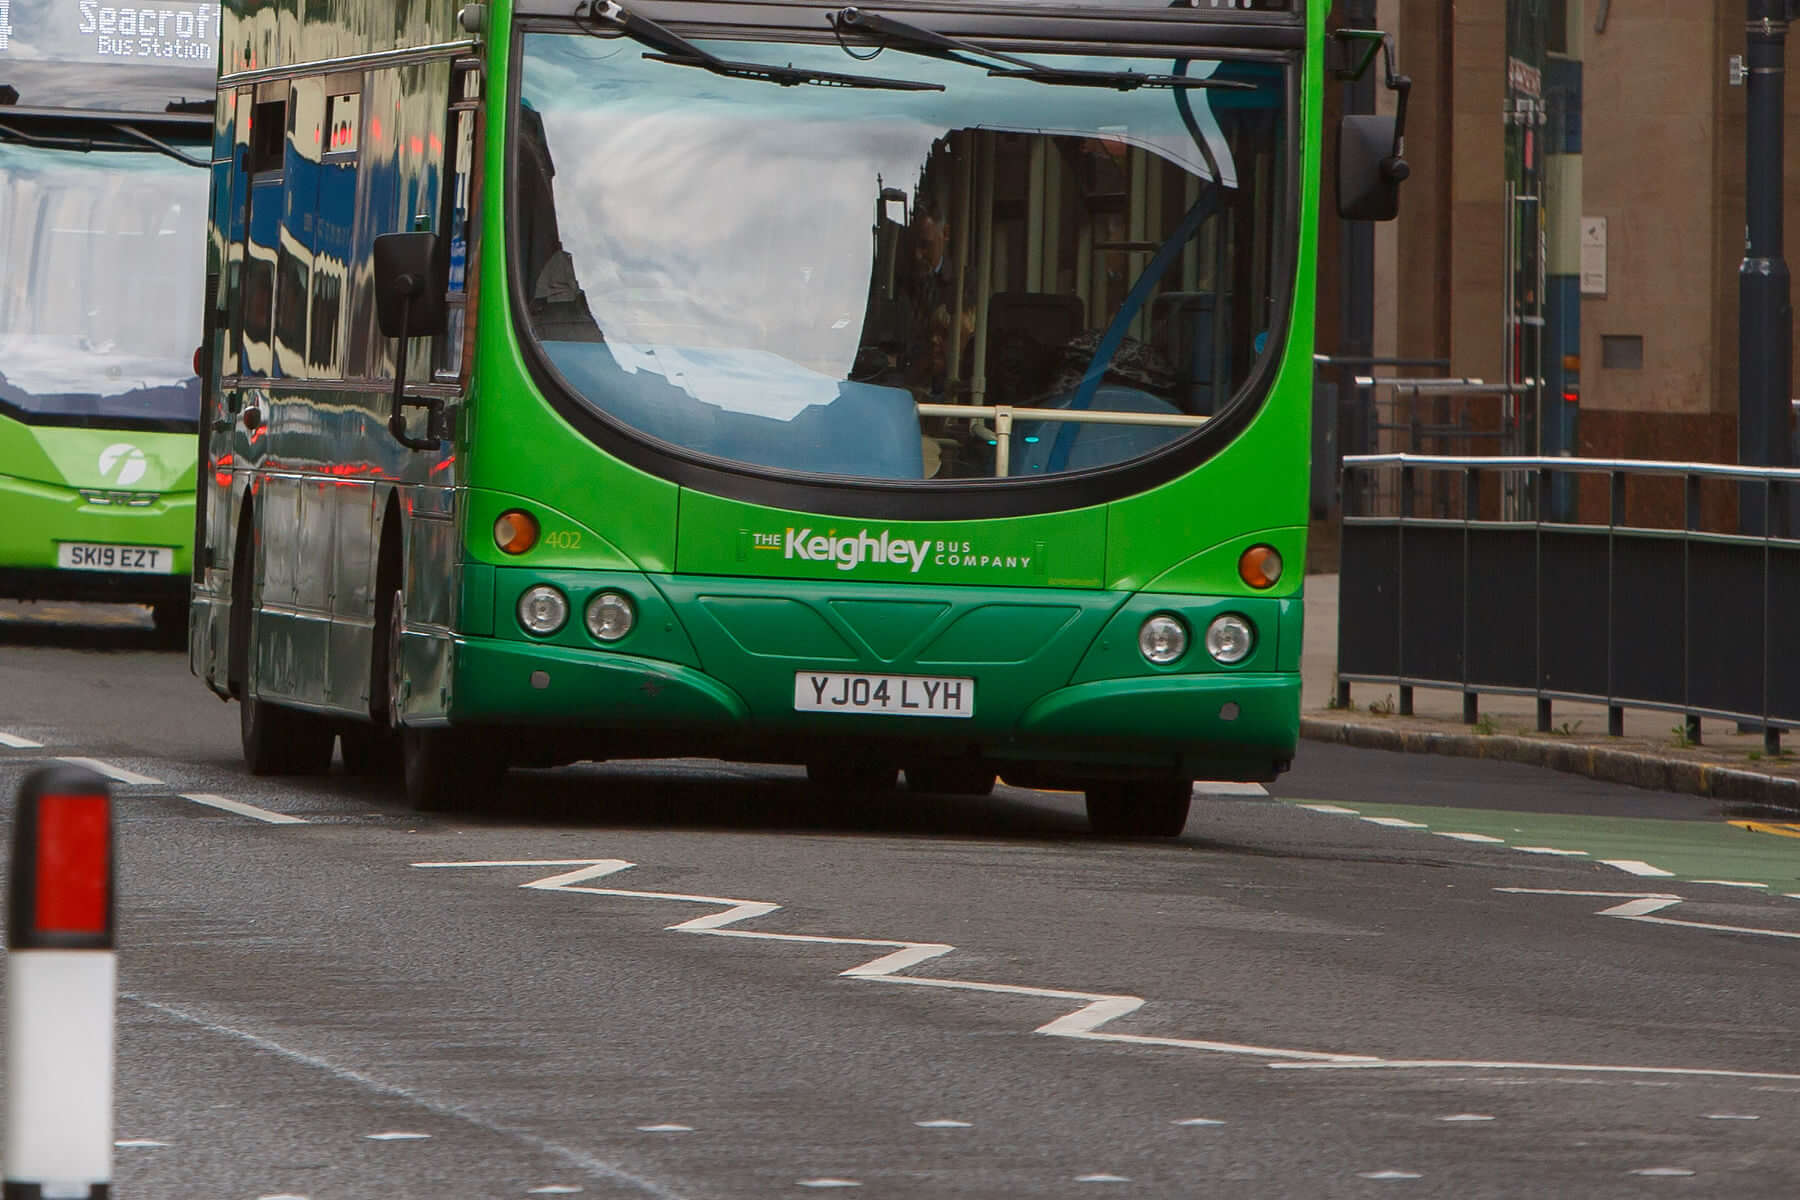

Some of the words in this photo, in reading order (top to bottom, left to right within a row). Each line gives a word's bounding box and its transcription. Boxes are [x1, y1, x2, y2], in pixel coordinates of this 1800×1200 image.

[97, 35, 134, 55] Bus
[137, 38, 211, 59] Station
[543, 531, 582, 549] 402
[753, 534, 781, 546] THE
[784, 527, 932, 573] Keighley
[935, 541, 971, 553] BUS
[71, 546, 115, 566] SK19
[120, 549, 160, 568] EZT
[934, 555, 1031, 568] COMPANY
[810, 676, 891, 707] YJ04
[900, 679, 962, 710] LYH
